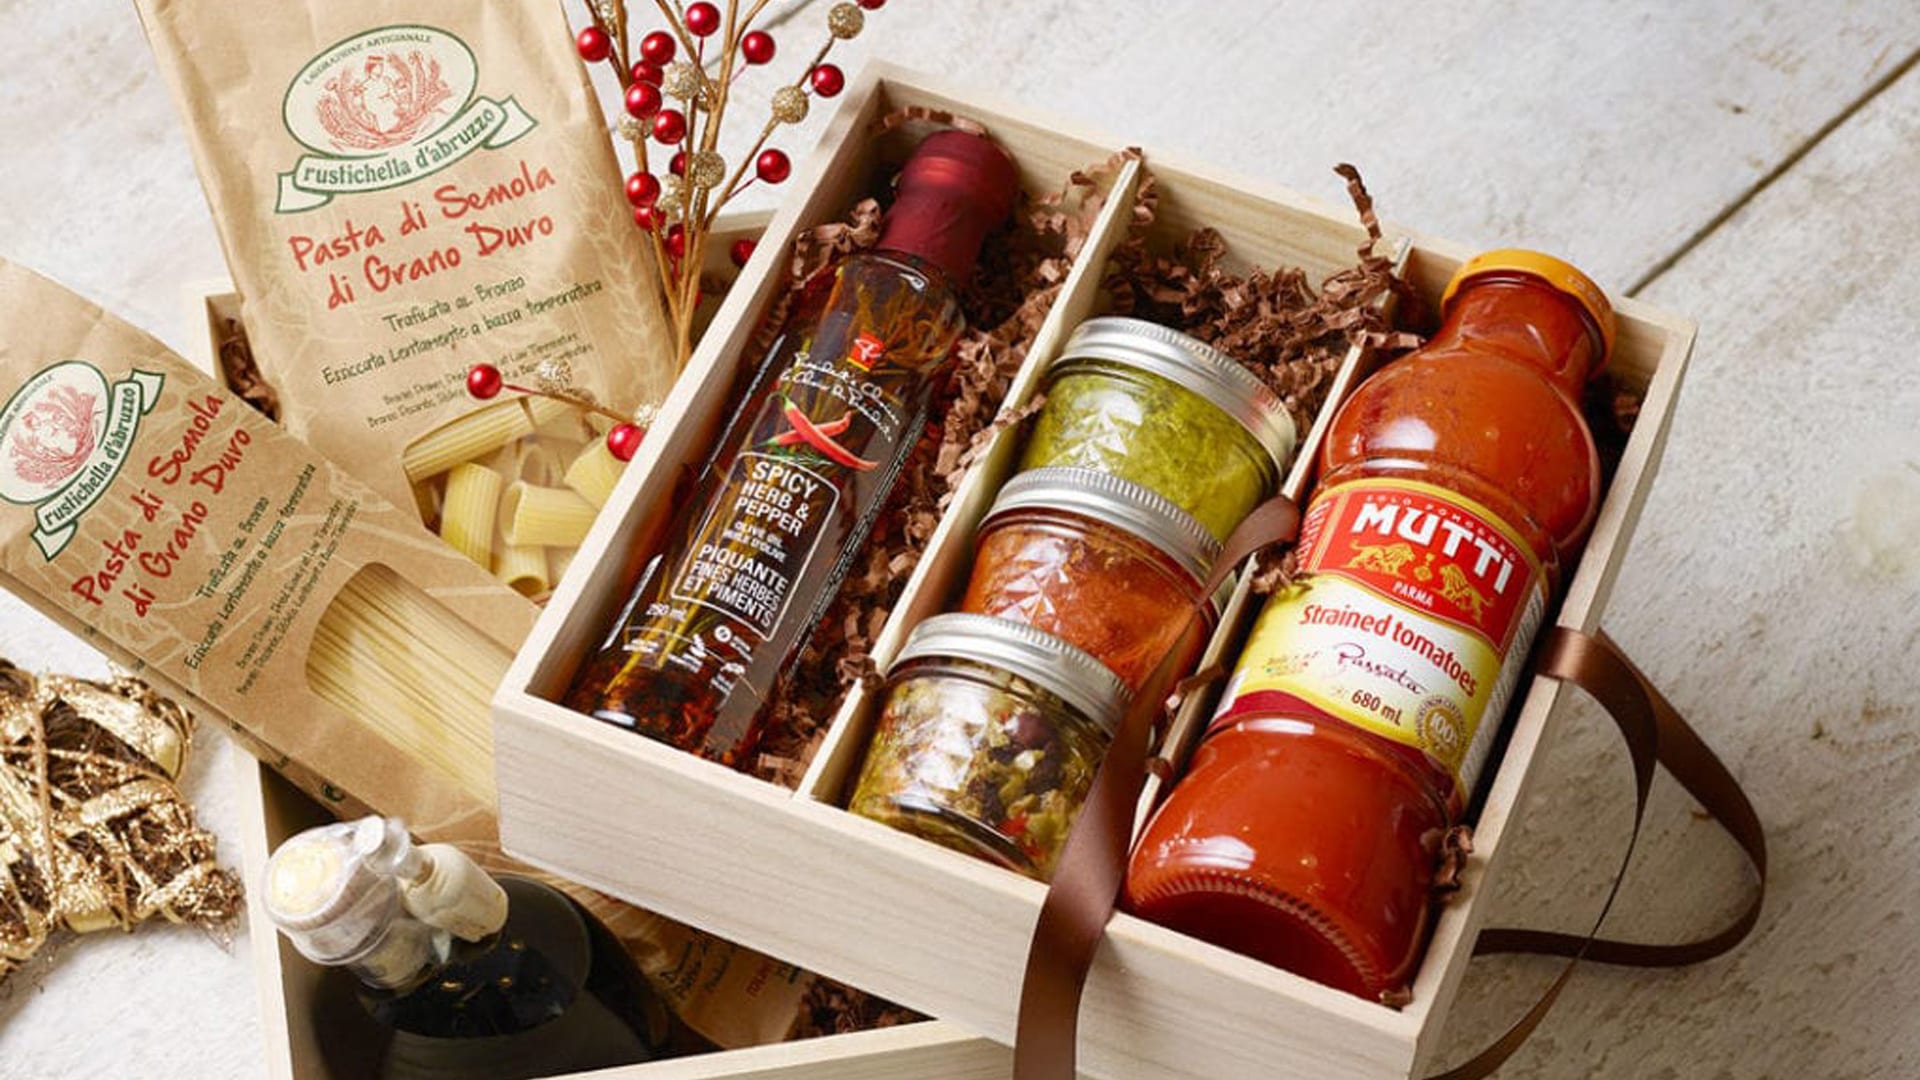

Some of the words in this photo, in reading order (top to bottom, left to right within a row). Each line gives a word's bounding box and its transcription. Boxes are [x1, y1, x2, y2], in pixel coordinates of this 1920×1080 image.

[303, 158, 411, 185] rustichella
[416, 108, 495, 169] d'abruzzo
[288, 220, 385, 271] Pasta
[399, 202, 427, 237] di
[434, 160, 556, 219] Semola
[327, 274, 355, 310] di
[364, 246, 461, 292] Grano
[466, 217, 553, 257] Duro
[471, 323, 480, 336] a
[483, 308, 521, 333] bassa
[44, 460, 110, 527] rustichella
[104, 387, 137, 459] d'abruzzo
[190, 428, 251, 495] Duro
[752, 461, 819, 500] SPICY
[71, 529, 142, 606] Pasta
[130, 488, 164, 523] di
[148, 394, 225, 485] Semola
[734, 496, 803, 537] PEPPER
[740, 480, 793, 511] HERB
[795, 502, 810, 522] &
[138, 501, 208, 579] Grano
[1352, 503, 1513, 594] MUTTI
[1426, 502, 1518, 562] POMODORO
[689, 559, 731, 587] FINES
[731, 572, 783, 613] HERBES
[698, 543, 789, 594] PIQUANTE
[1393, 582, 1434, 607] PARMA
[122, 582, 155, 618] di
[682, 574, 707, 593] ET
[708, 581, 775, 629] PIMENTS
[1299, 603, 1392, 637] Strained
[1391, 621, 1478, 699] tomatoes
[1336, 644, 1428, 694] Passata
[1351, 688, 1381, 713] 680
[1381, 701, 1404, 727] mL
